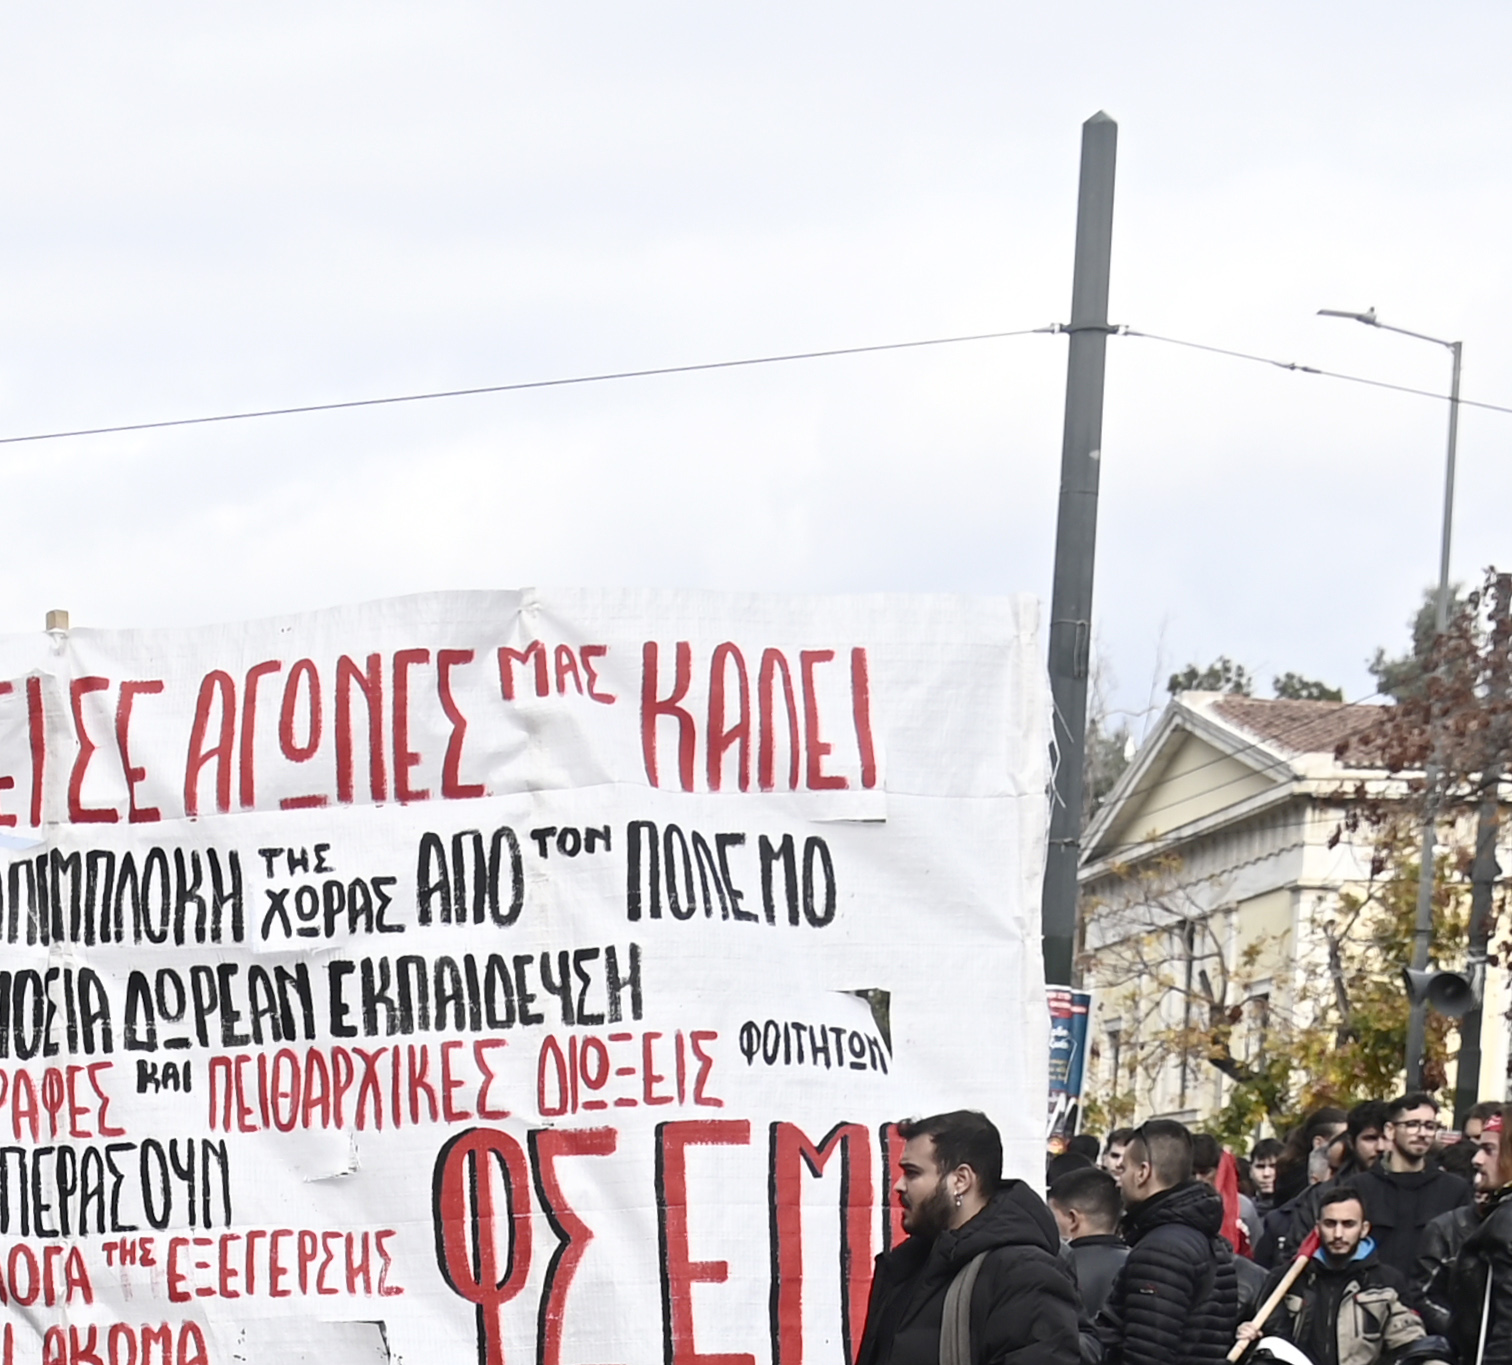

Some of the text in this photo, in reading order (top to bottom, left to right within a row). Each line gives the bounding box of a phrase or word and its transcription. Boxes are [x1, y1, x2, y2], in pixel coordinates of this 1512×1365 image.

[67, 677, 165, 826] ΣΕ
[183, 647, 495, 822] ΑΓΩΝΕΣ
[496, 640, 618, 706] ΜΑΣ
[638, 639, 877, 796] ΚΑΛΕΙ
[259, 842, 335, 877] ΤΗΣ
[416, 826, 524, 928] ΑΠΟ
[529, 824, 613, 861] ΤΟΝ
[626, 818, 838, 928] ΠΟΛΕΜΟ
[259, 876, 406, 939] ΧΩΡΑΣ
[124, 958, 315, 1053] ΔΩΡΕΑΝ
[327, 942, 644, 1039] ΕΚΠΑΙΔΕΥΣΗ
[136, 1058, 192, 1094] ΚΑΙ
[208, 1038, 510, 1132] ΠΕΙΘΑΡΧΙΚΕΣ
[536, 1029, 724, 1116] ΔΙΩΞΕΙΣ
[102, 1236, 158, 1270] ΤΗΣ
[166, 1226, 406, 1303] ΕΞΕΓΕΡΣΗΣ
